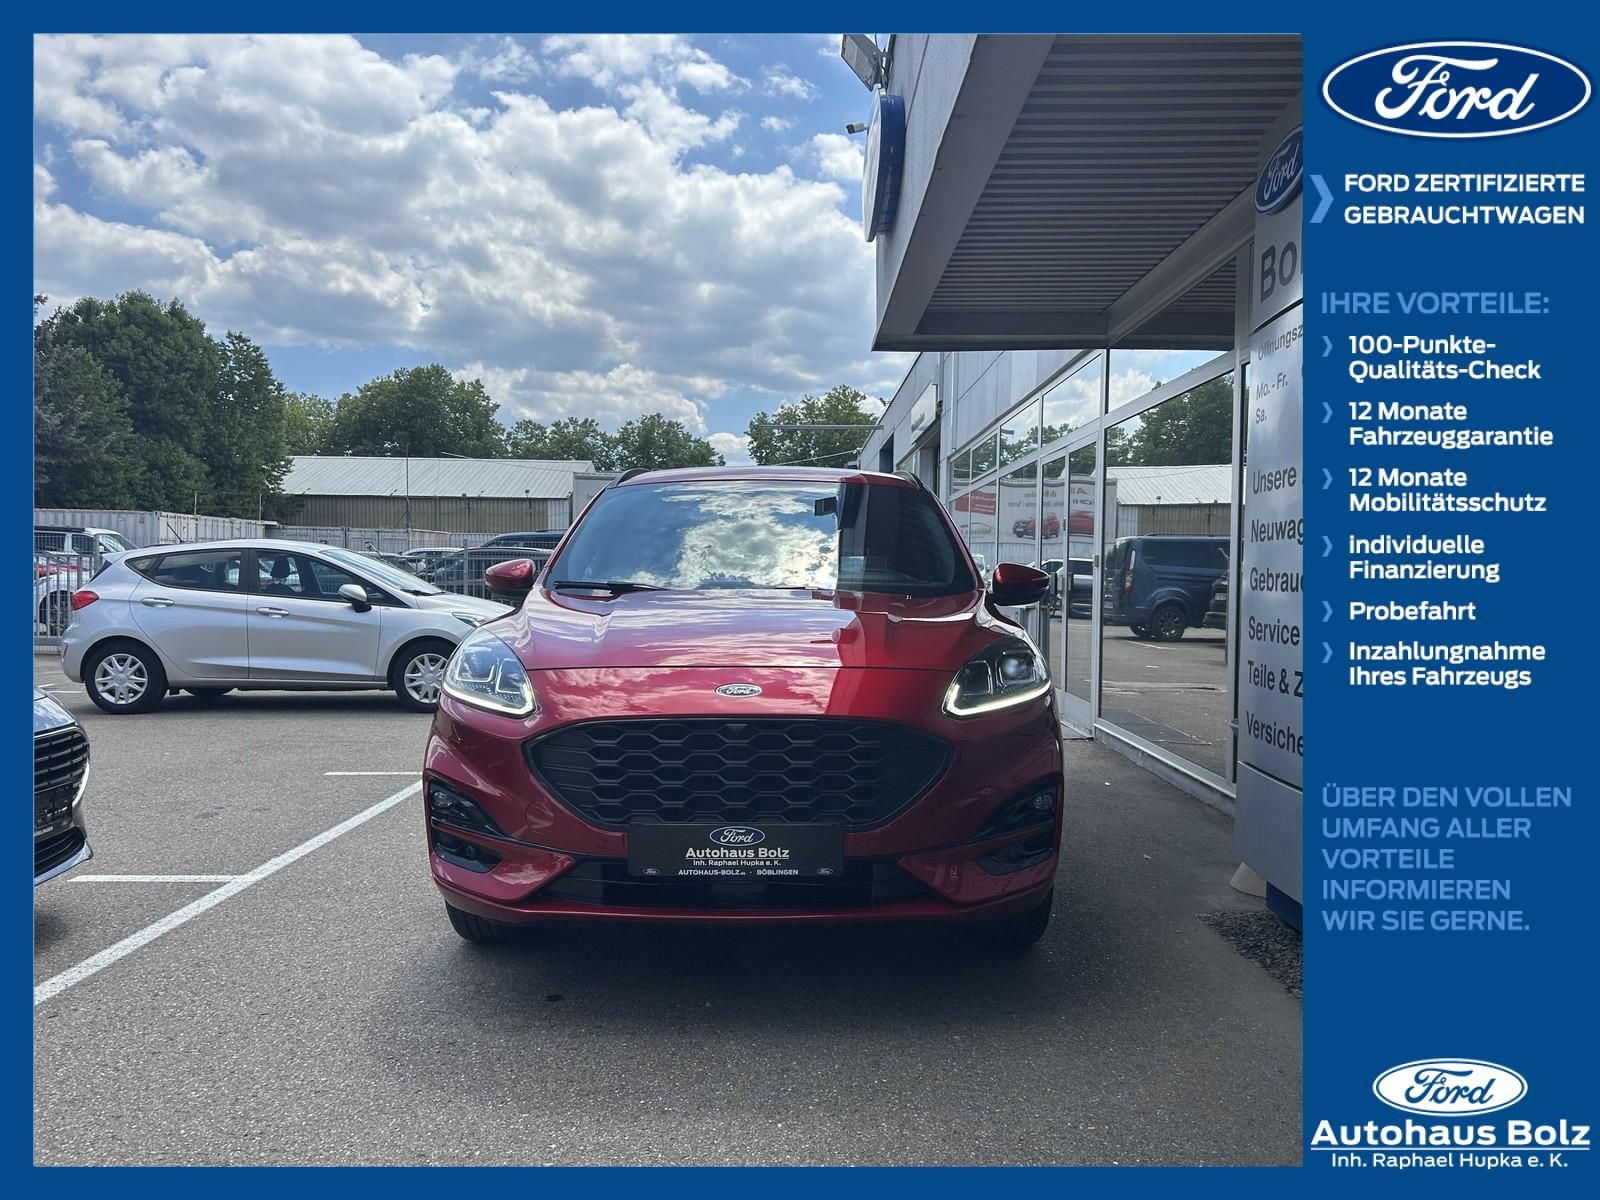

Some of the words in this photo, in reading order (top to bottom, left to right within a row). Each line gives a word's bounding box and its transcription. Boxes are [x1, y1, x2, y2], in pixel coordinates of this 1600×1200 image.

[1263, 142, 1300, 201] Ford
[1260, 240, 1303, 304] BO
[1256, 382, 1271, 401] Mo.
[1276, 372, 1288, 390] Fr.
[1255, 407, 1268, 425] Sa.
[1252, 466, 1297, 495] Unsere
[1250, 518, 1304, 546] Neuwag
[1248, 615, 1301, 647] Service
[1247, 659, 1276, 691] Teile
[1279, 667, 1290, 696] &
[1293, 669, 1303, 698] Z
[1246, 710, 1303, 757] Versiche
[719, 828, 755, 844] Ford
[685, 847, 756, 858] Autohaus
[757, 847, 790, 858] Bolz
[708, 859, 739, 867] Raphael
[740, 859, 765, 867] Hupka
[756, 868, 799, 876] BÖBLINGEN
